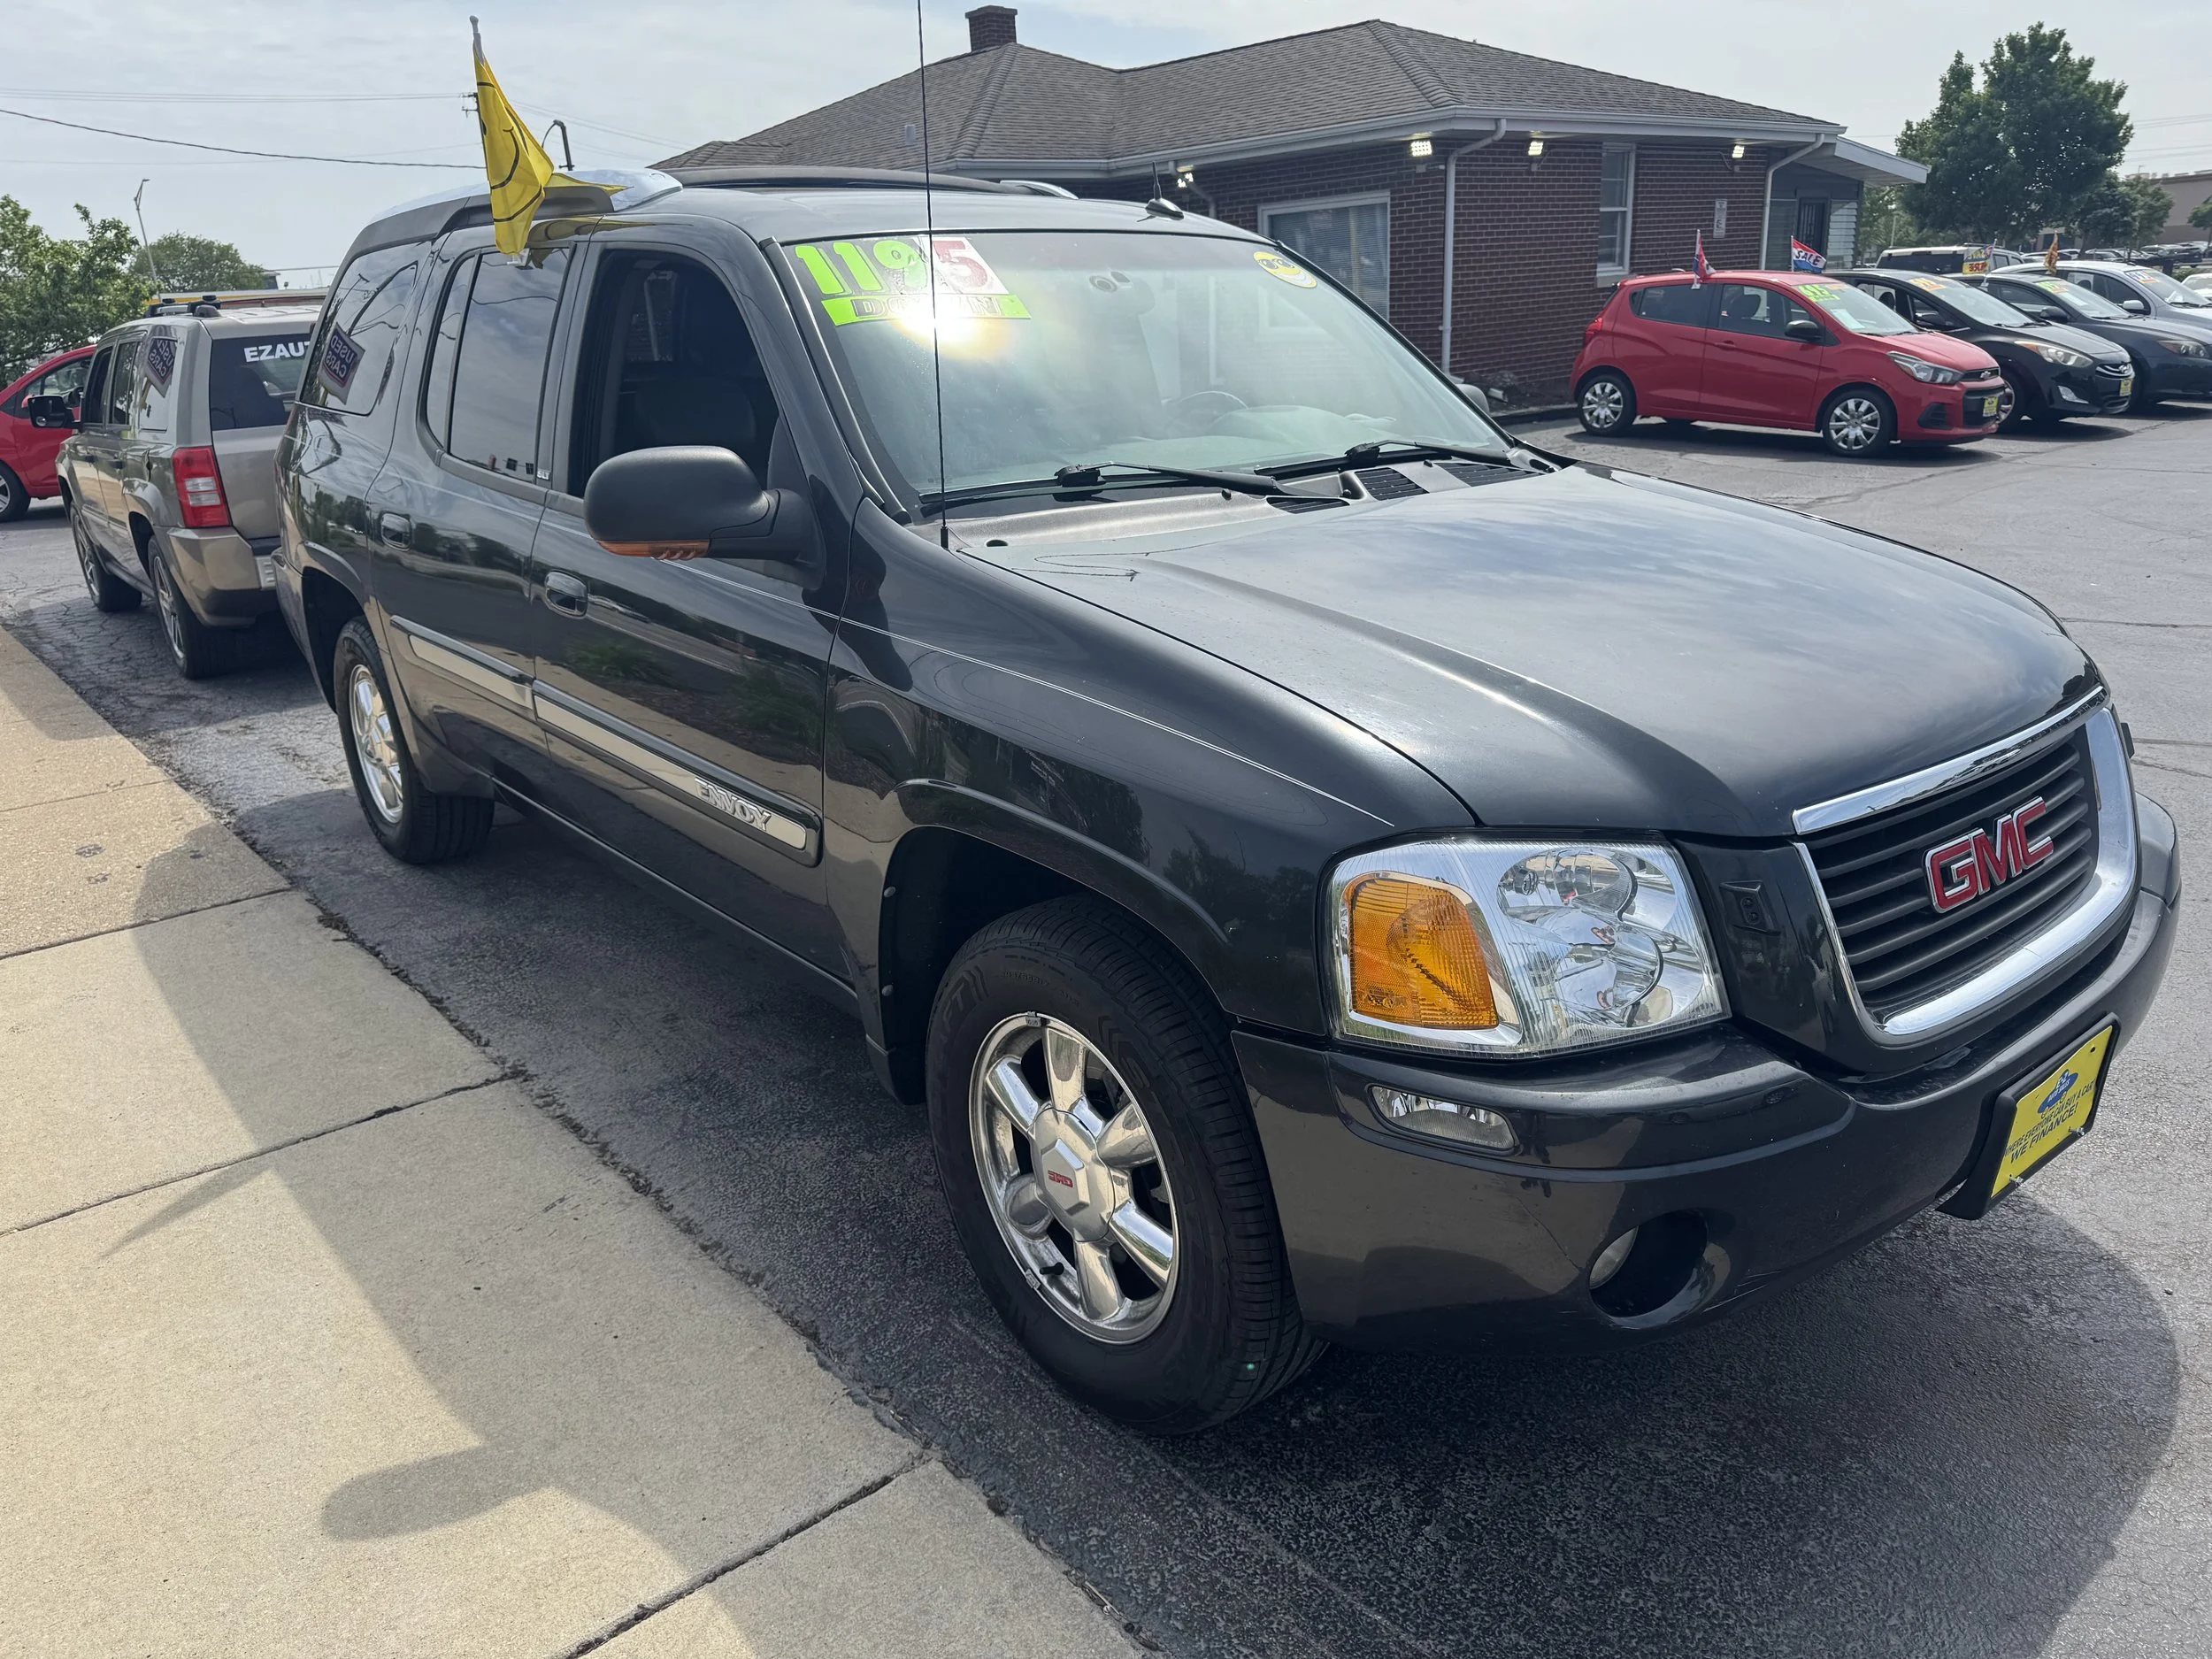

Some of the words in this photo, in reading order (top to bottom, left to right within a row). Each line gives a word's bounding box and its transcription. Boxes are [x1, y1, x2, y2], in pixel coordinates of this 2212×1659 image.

[1795, 250, 1823, 265] SALE
[851, 296, 1002, 318] DN
[695, 777, 772, 832] ENVOY
[1924, 795, 2055, 914] GMC
[2010, 1141, 2029, 1164] WE
[2030, 1101, 2078, 1148] FINANCE!
[1048, 1170, 1073, 1188] GMC
